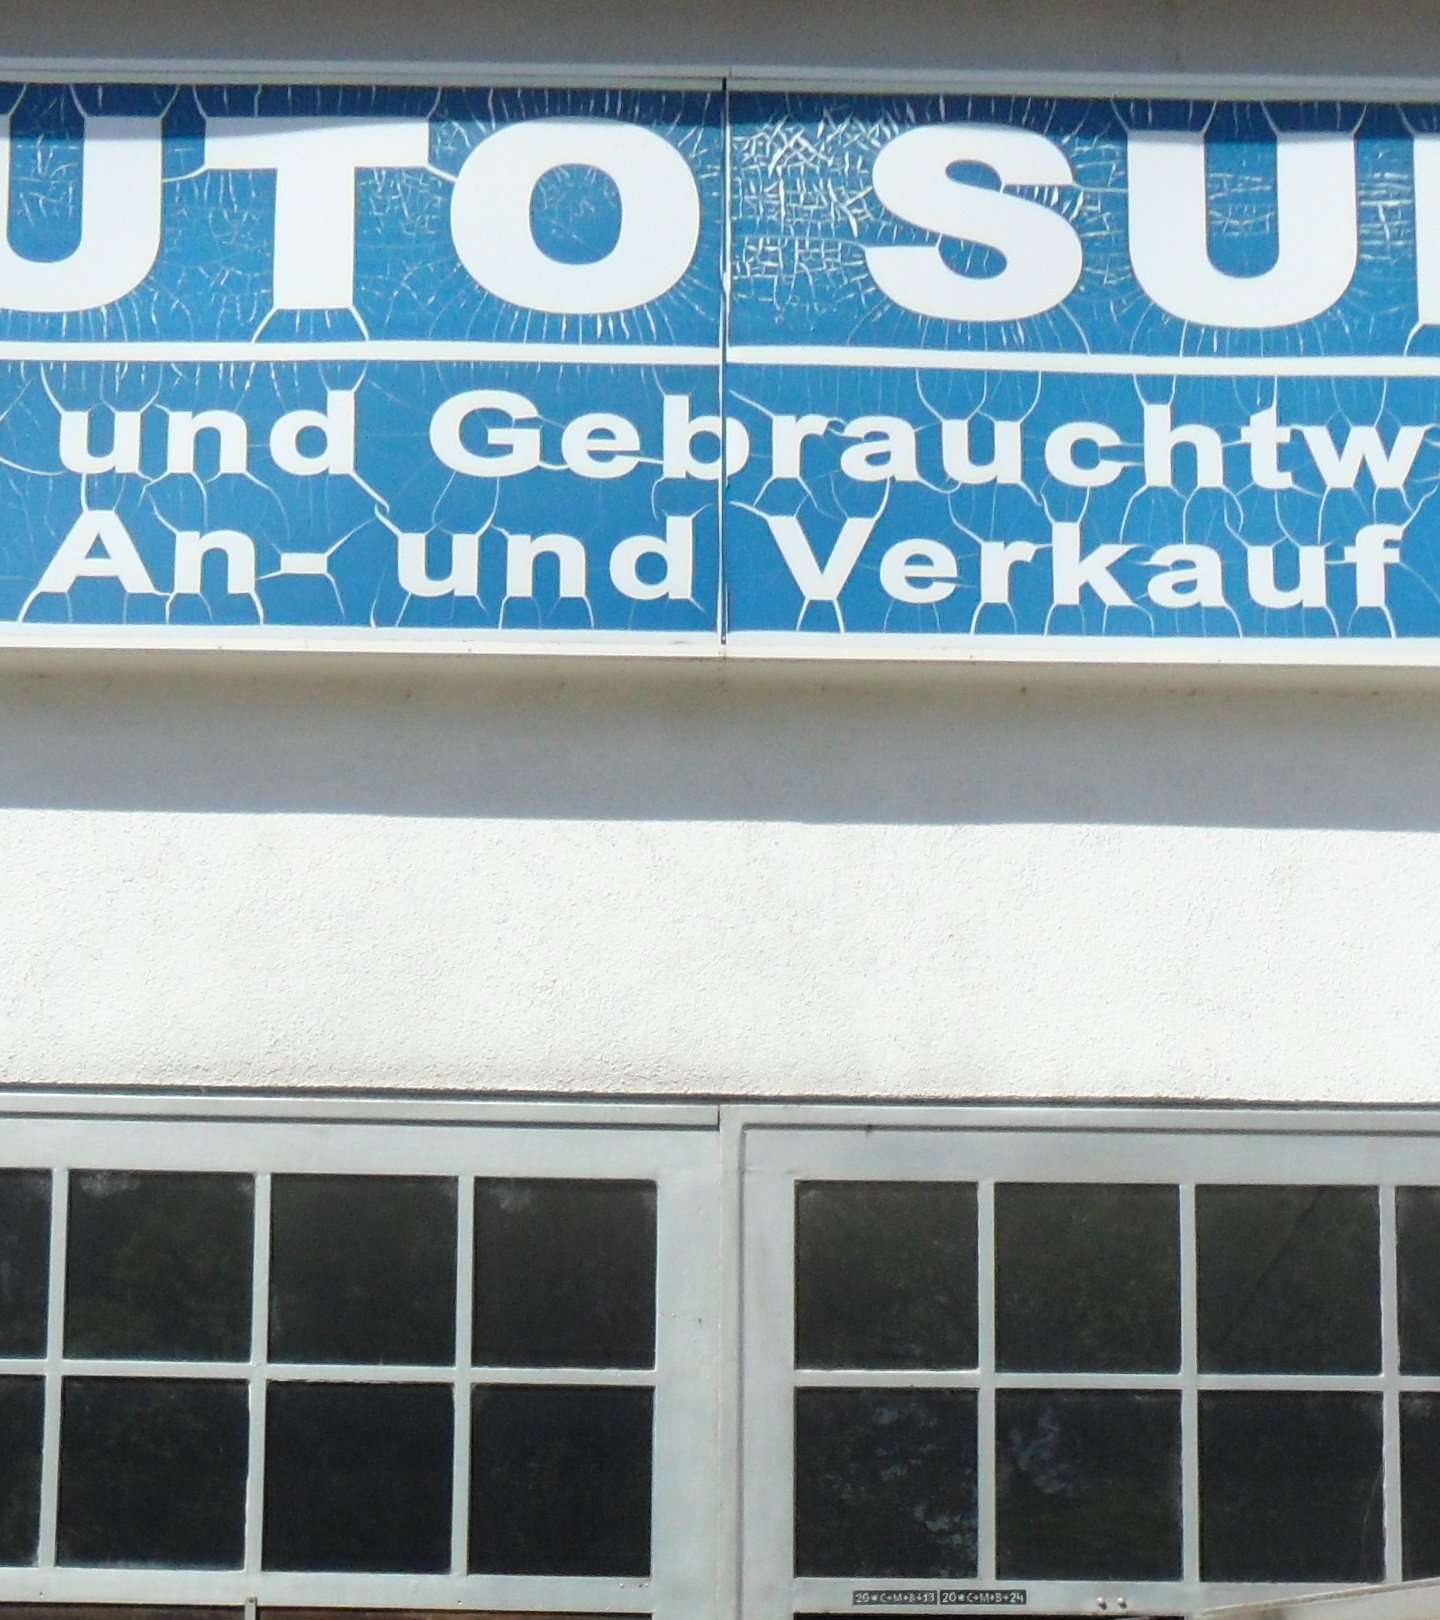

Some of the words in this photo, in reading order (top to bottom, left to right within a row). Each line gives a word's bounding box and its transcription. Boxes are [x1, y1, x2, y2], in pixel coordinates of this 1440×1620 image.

[58, 390, 356, 477] und
[36, 509, 329, 596] An-
[396, 515, 695, 600] und
[768, 515, 1410, 610] Verkauf
